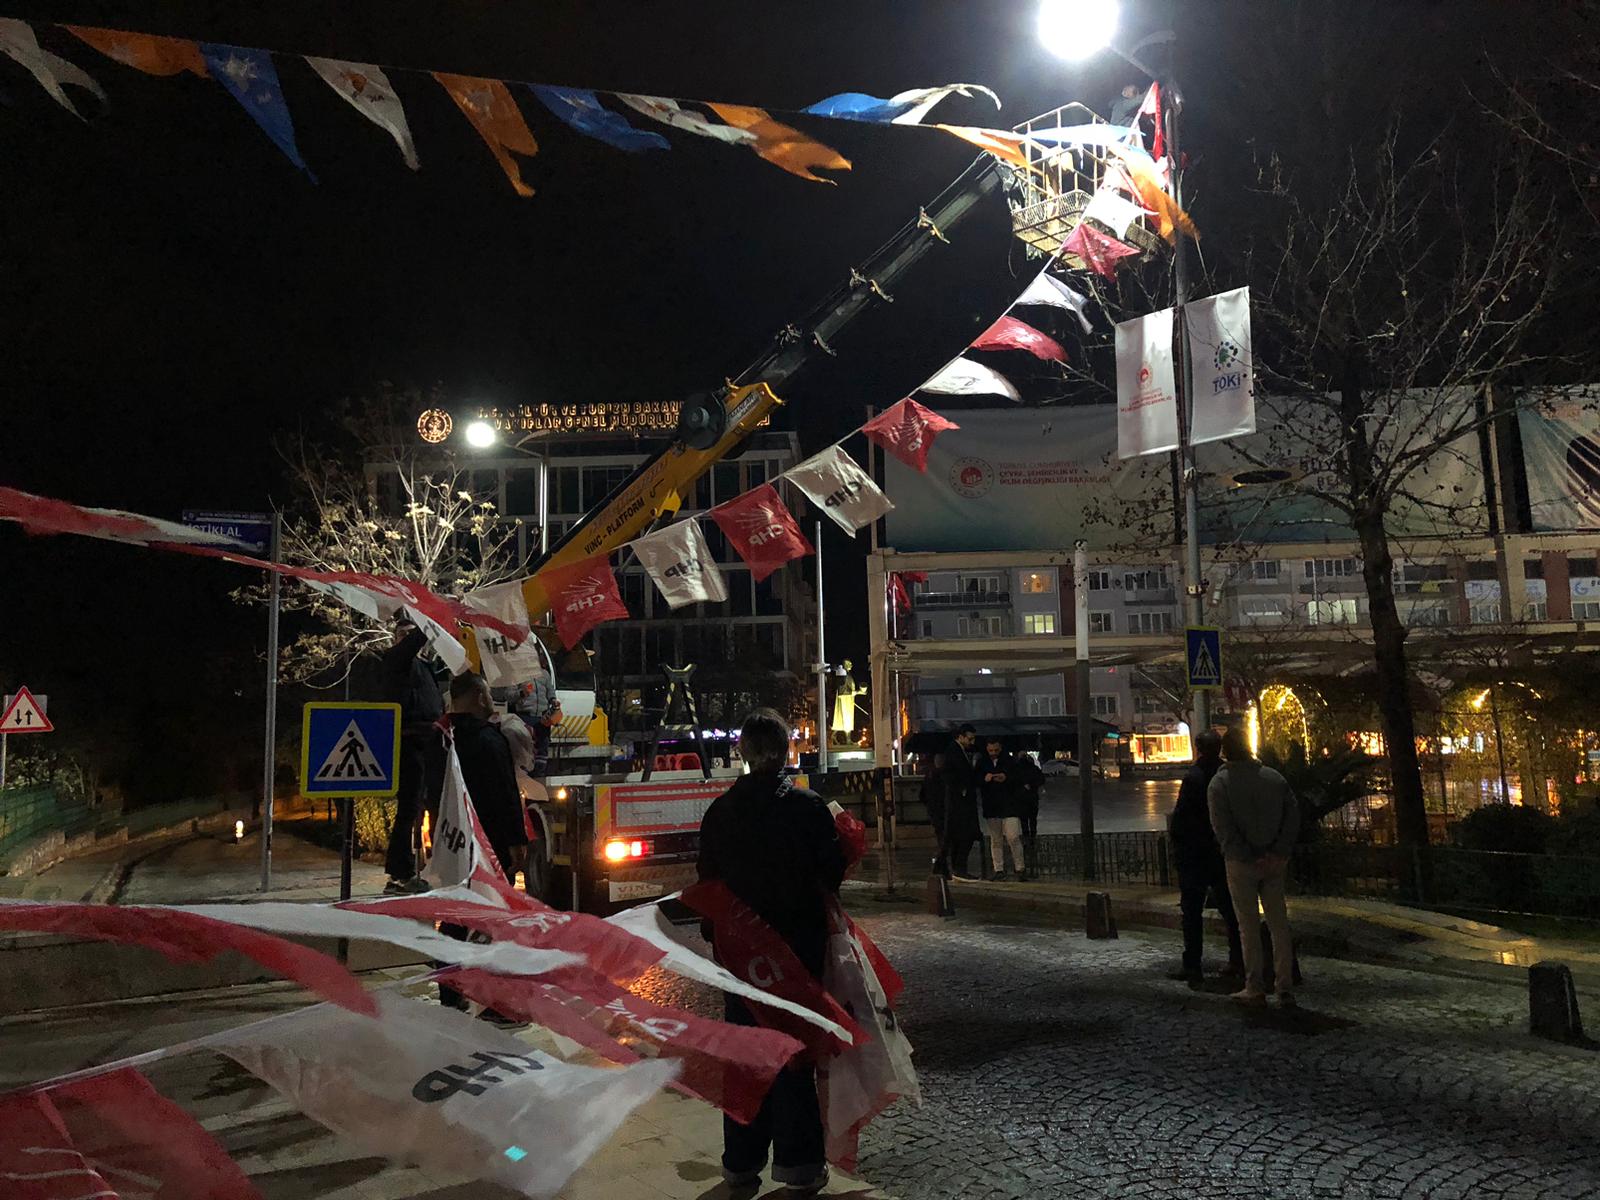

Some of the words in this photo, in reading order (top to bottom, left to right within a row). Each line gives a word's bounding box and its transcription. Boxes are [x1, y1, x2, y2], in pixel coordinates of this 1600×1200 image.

[561, 404, 577, 416] VE
[633, 400, 684, 414] BAKAN
[606, 496, 646, 537] PLATFORM
